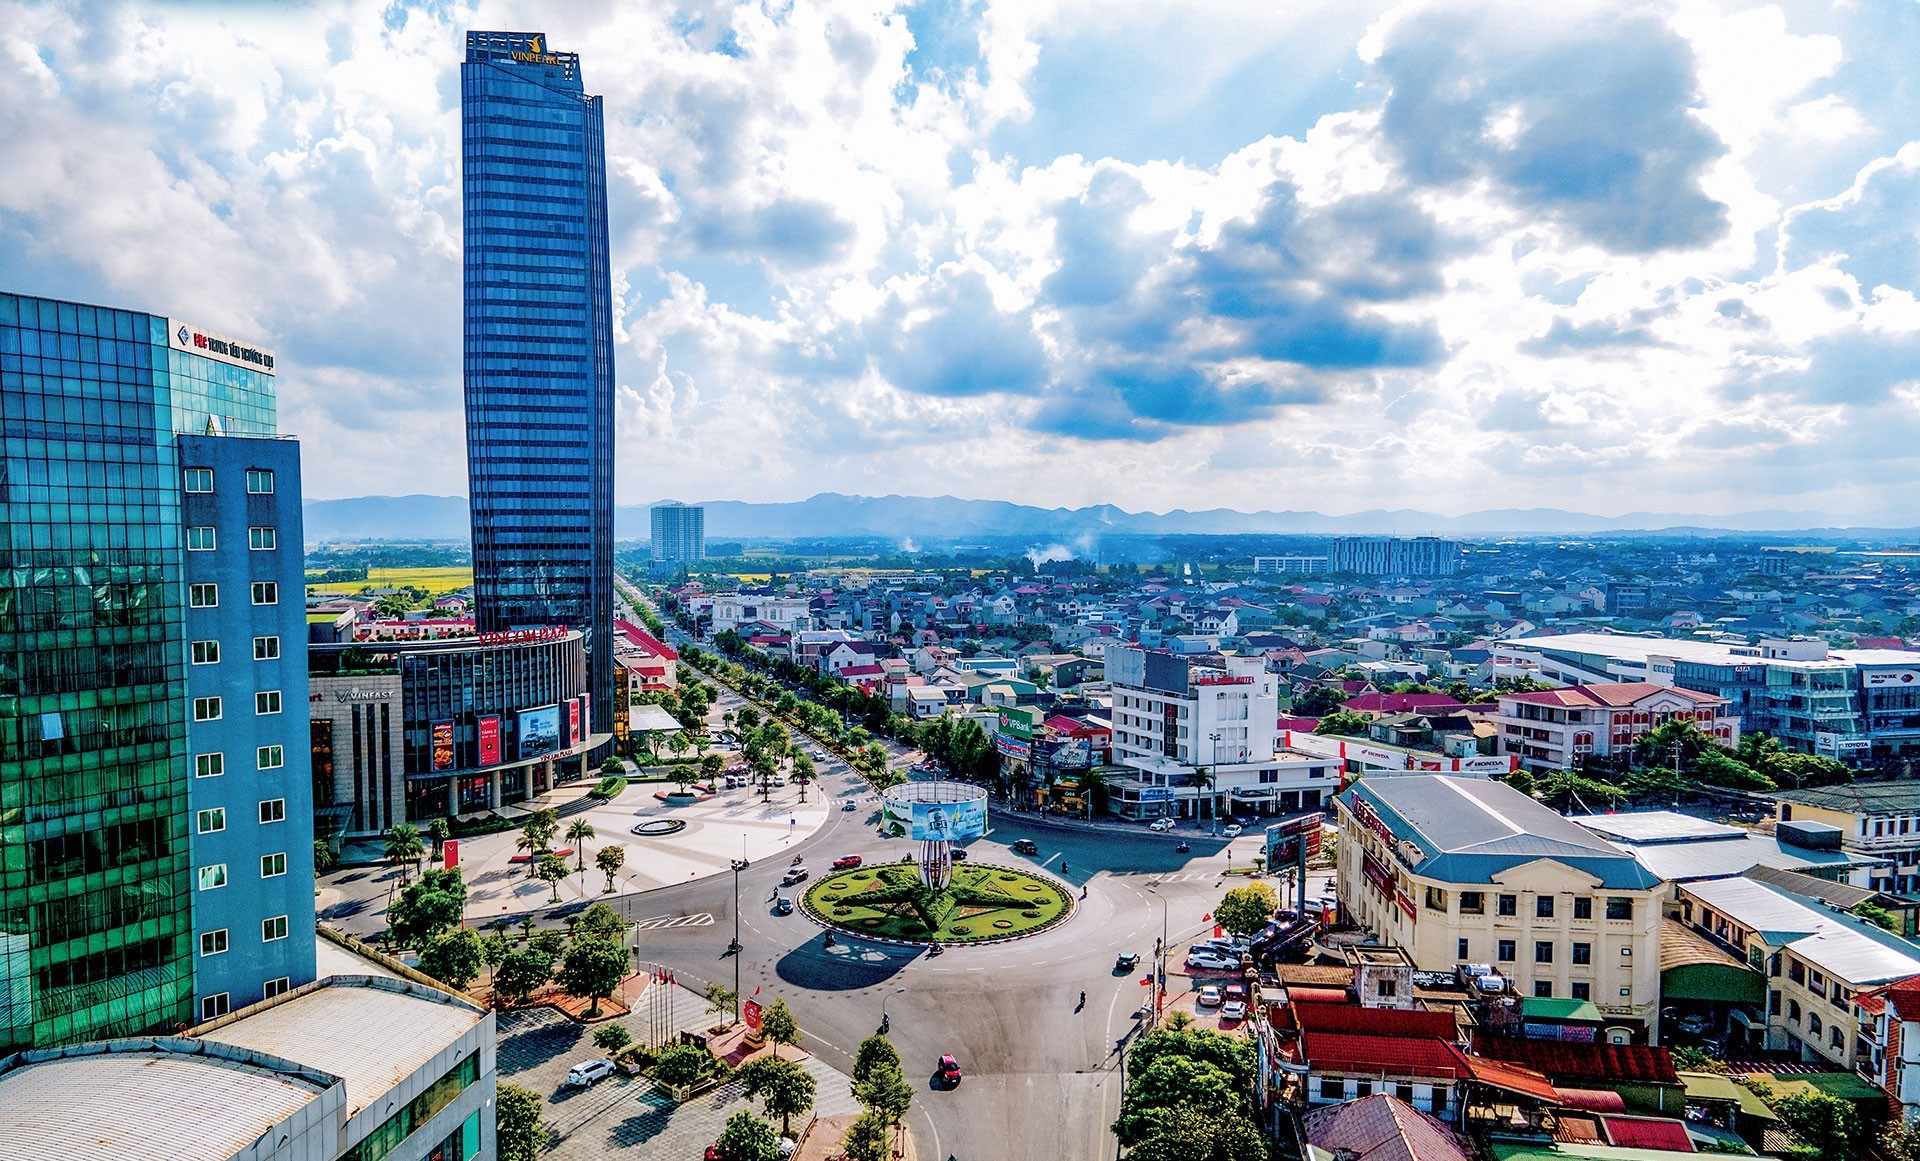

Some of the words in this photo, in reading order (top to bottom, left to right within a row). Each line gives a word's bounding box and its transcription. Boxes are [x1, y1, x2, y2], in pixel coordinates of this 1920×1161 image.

[511, 51, 562, 65] VINPEARL
[208, 337, 228, 355] TRUNG
[477, 629, 536, 646] VINCOM
[539, 624, 568, 641] PLAZA
[350, 690, 394, 700] VINFAST
[1008, 718, 1030, 732] VPBank
[1367, 751, 1390, 760] HONDA
